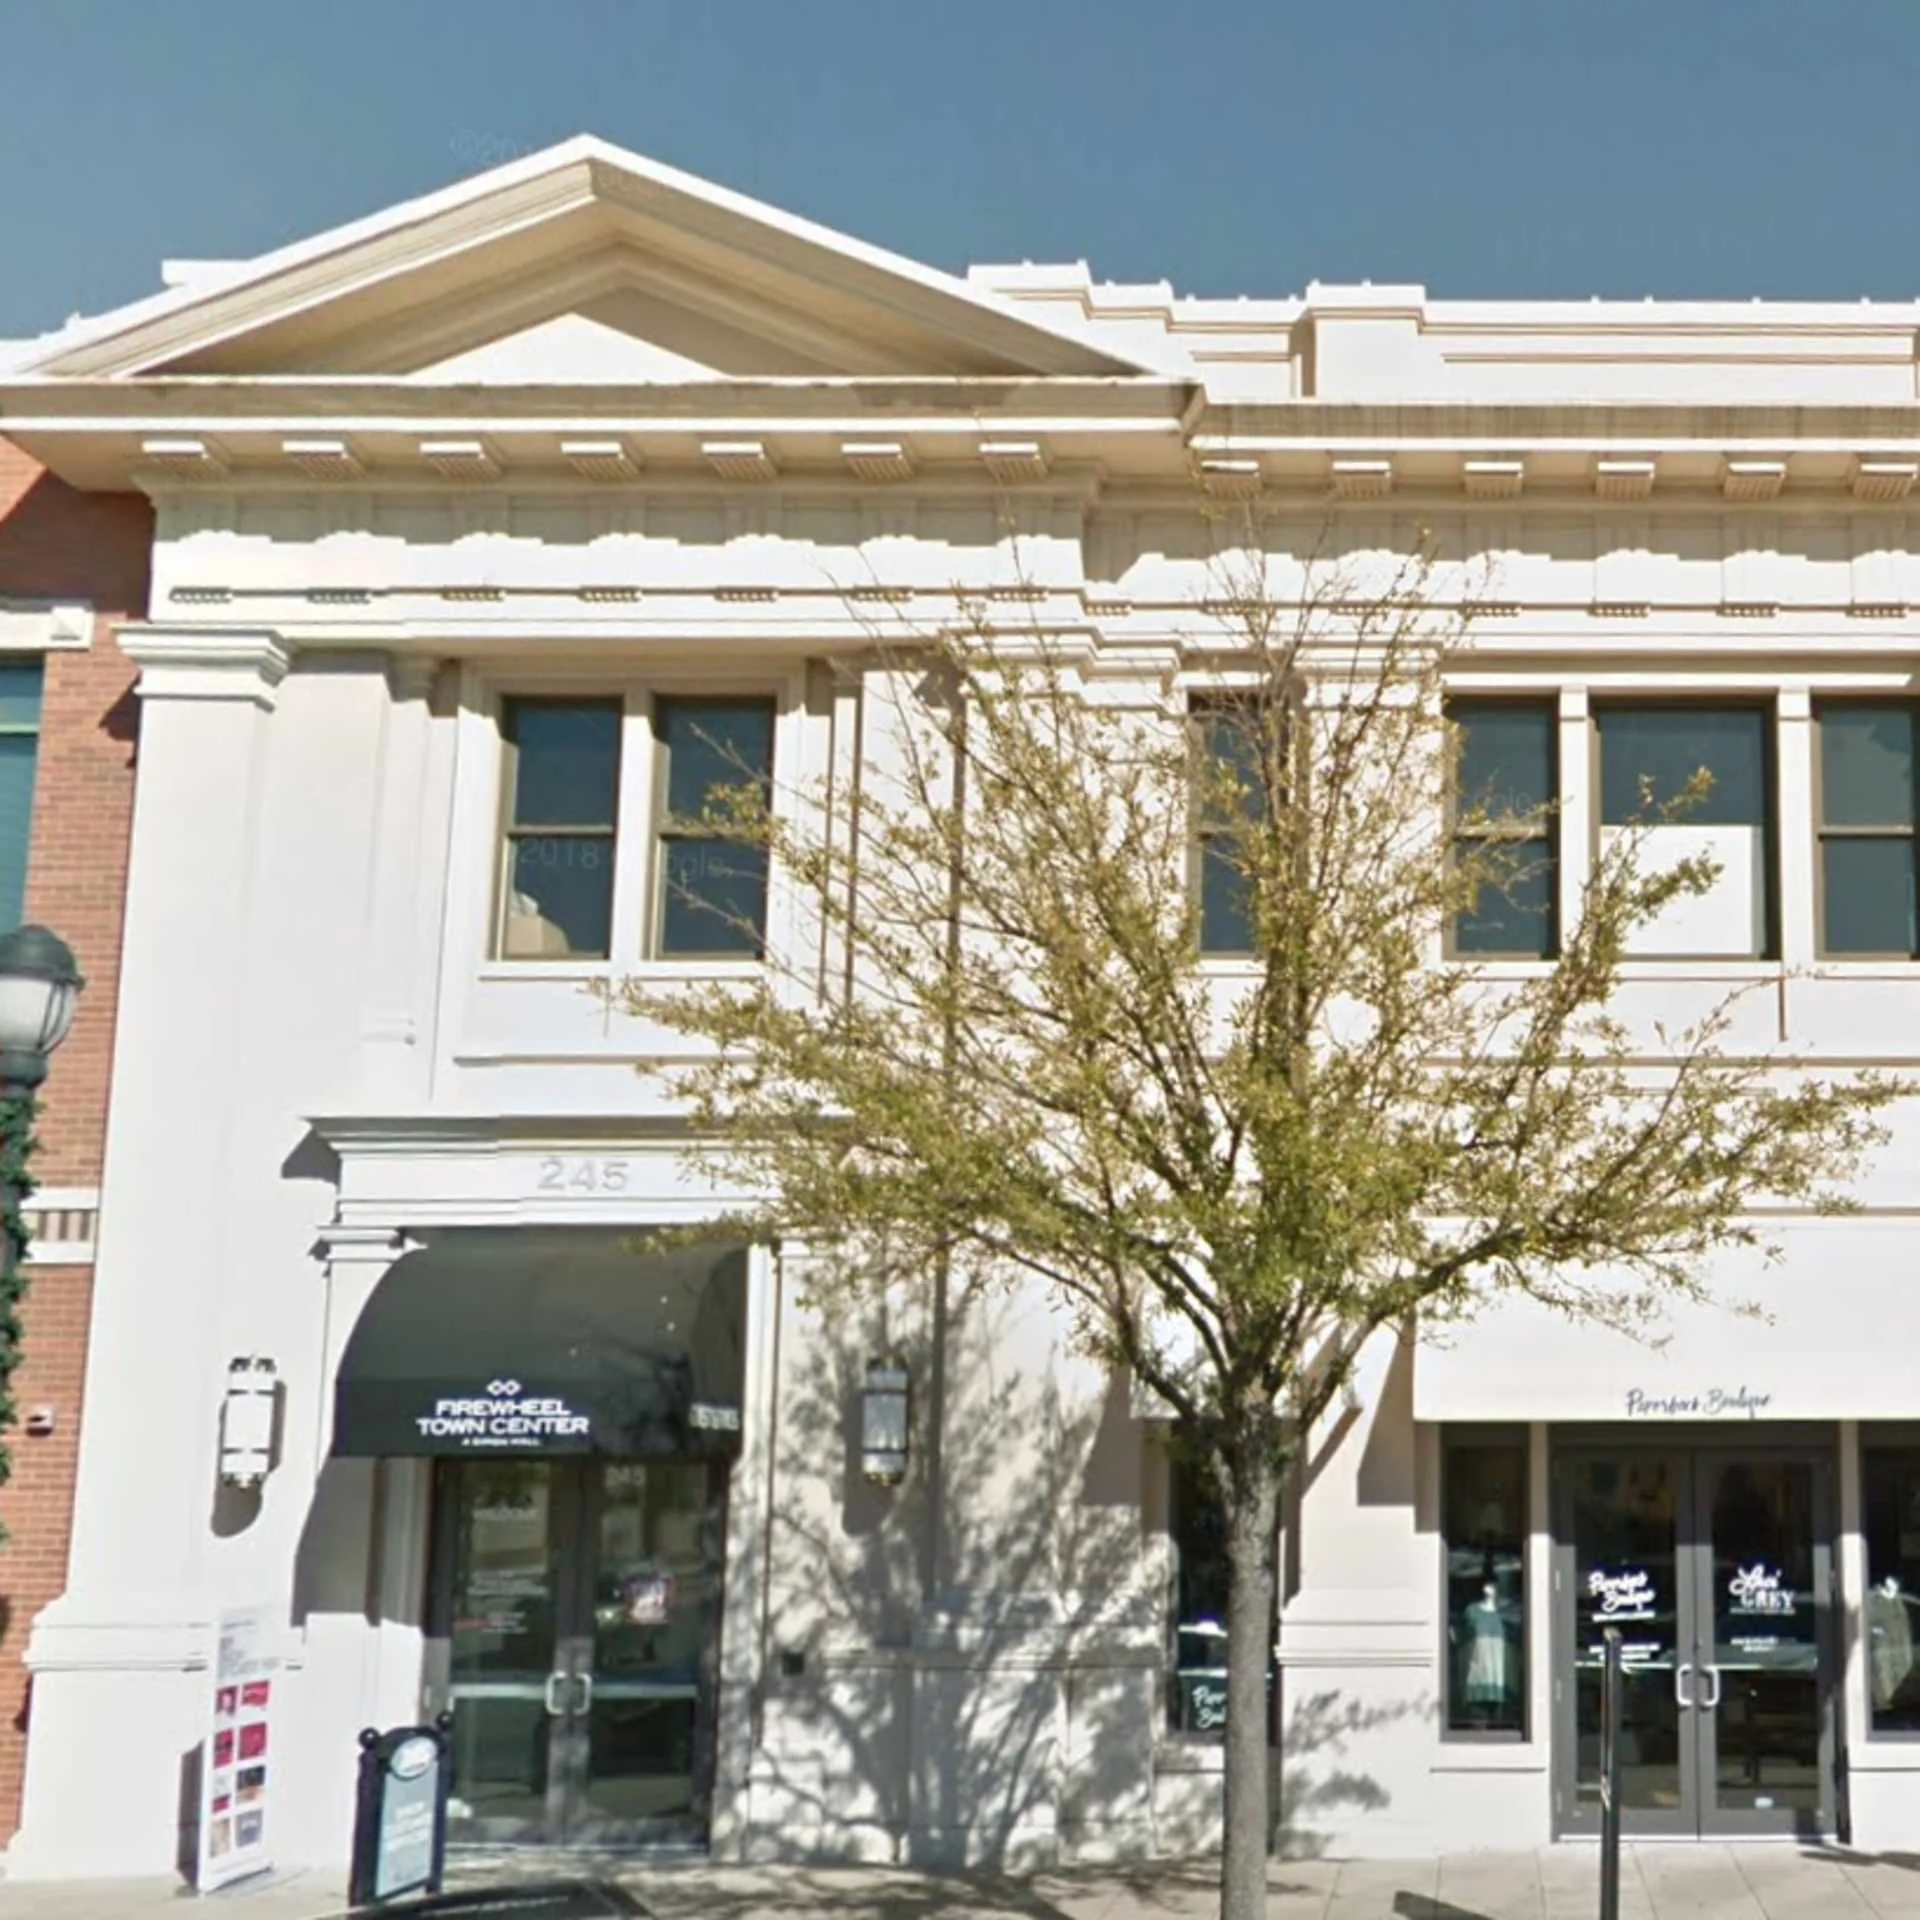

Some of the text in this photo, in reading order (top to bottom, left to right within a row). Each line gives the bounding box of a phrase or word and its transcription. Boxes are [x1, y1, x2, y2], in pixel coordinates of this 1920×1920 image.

[537, 1156, 629, 1191] 245
[435, 1399, 572, 1416] FIREWHEEL
[416, 1416, 589, 1436] TOWN CENTER
